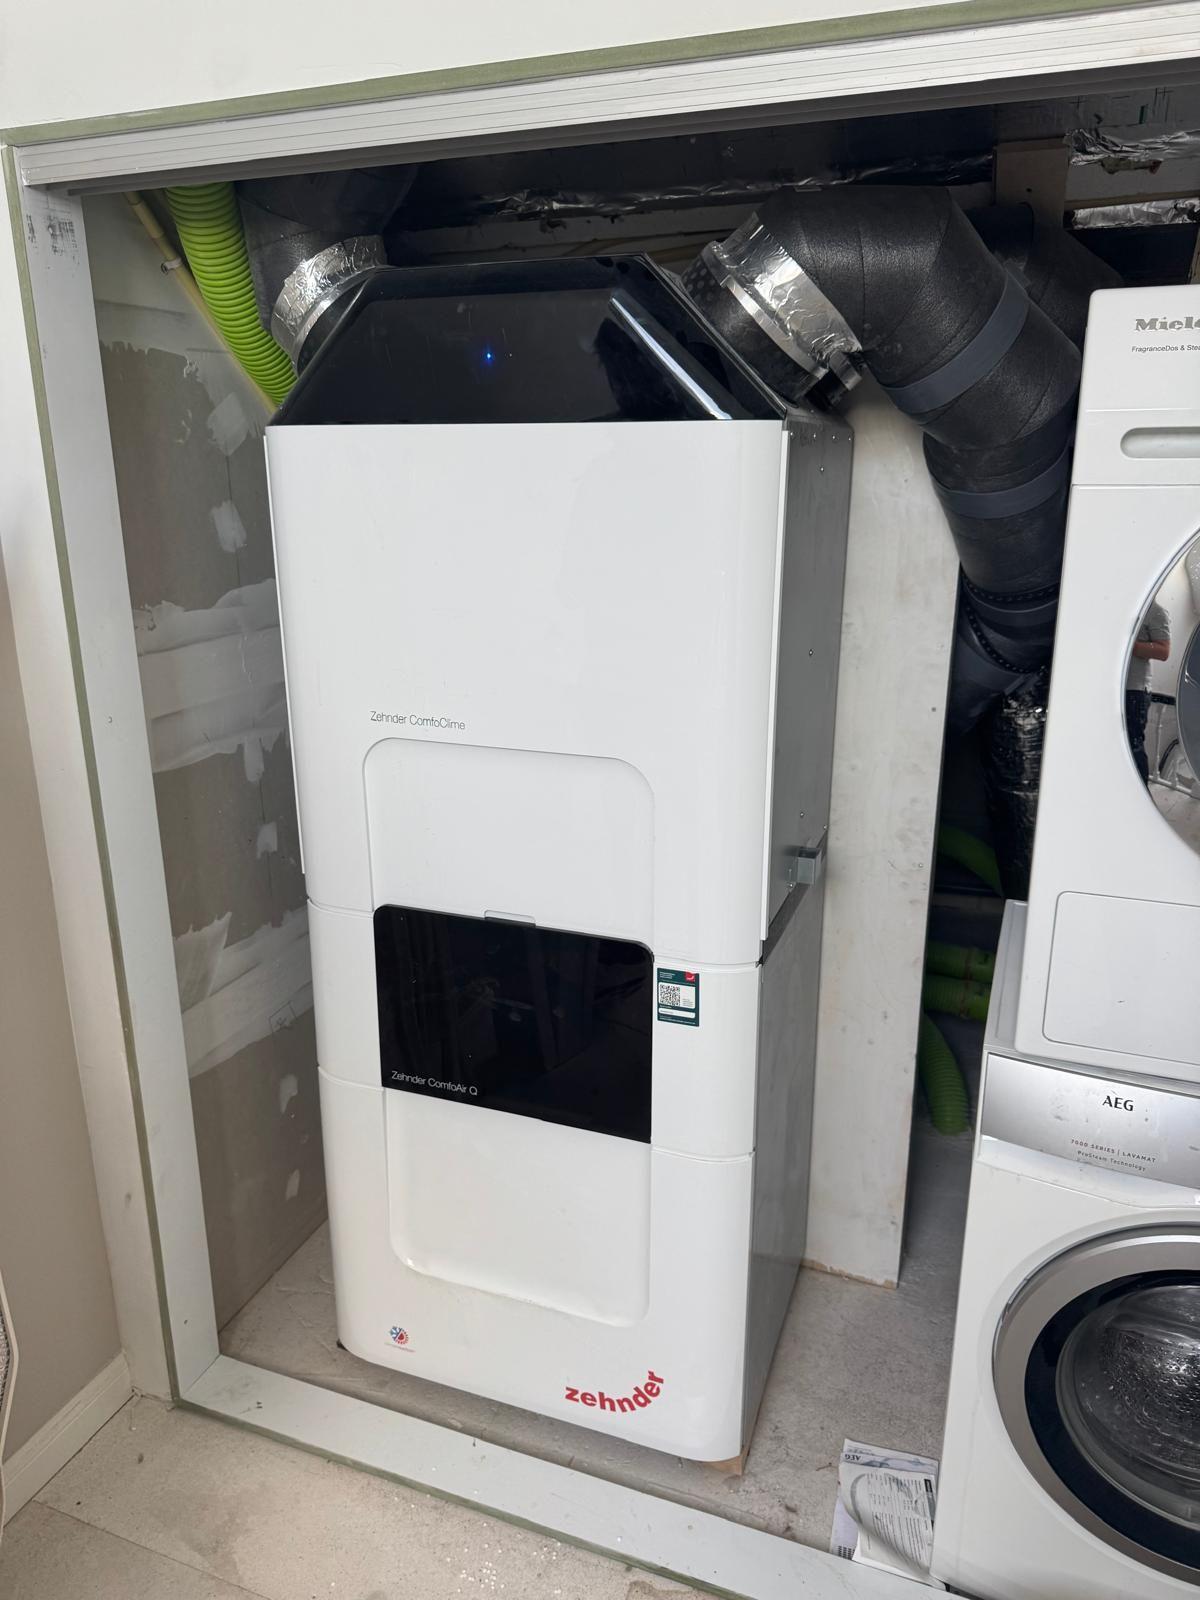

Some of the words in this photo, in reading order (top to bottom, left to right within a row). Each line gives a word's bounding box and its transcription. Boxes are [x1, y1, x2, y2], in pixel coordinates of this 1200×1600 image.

[1131, 345, 1179, 353] FragranceDos
[370, 710, 407, 724] Zehnder
[409, 714, 466, 730] ComfoClime
[391, 1070, 427, 1085] Zehnder
[427, 1077, 468, 1093] ComfoAir
[469, 1086, 478, 1096] Q
[1102, 1095, 1134, 1112] AEG
[1071, 1139, 1089, 1148] 7000
[1090, 1143, 1115, 1154] SERIES
[1122, 1151, 1156, 1163] LAVAMAT
[1077, 1150, 1107, 1162] ProSteam
[1110, 1157, 1146, 1172] Technology
[564, 1370, 665, 1413] zehnder
